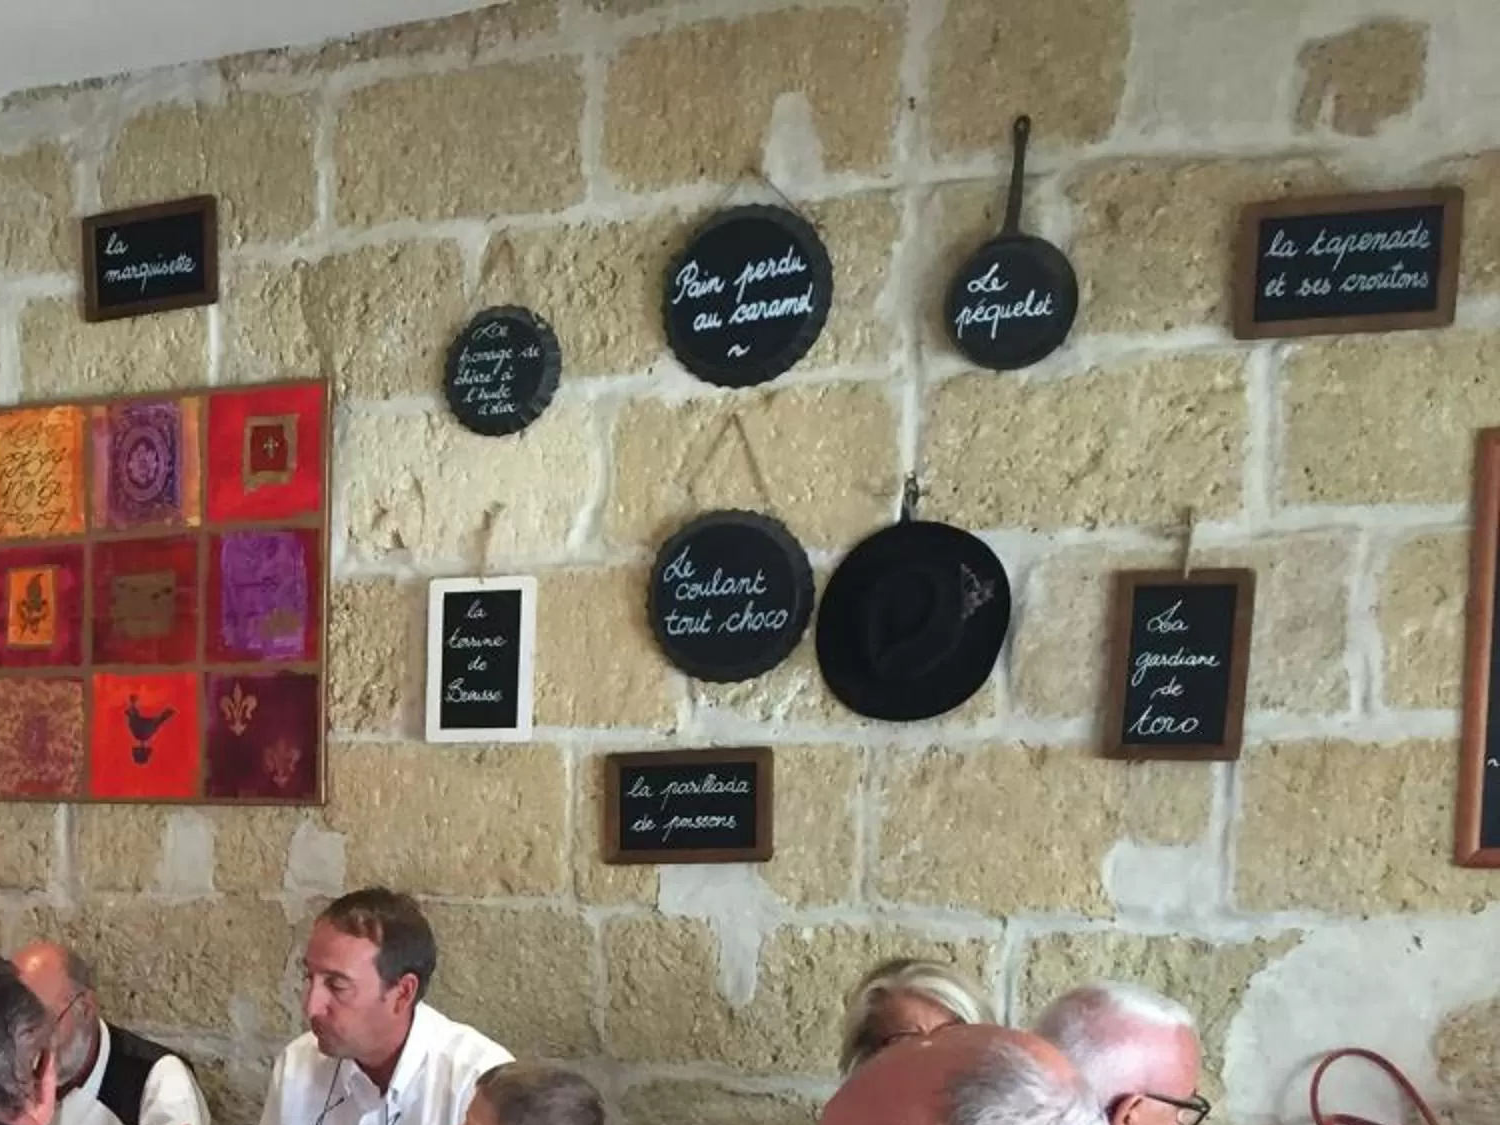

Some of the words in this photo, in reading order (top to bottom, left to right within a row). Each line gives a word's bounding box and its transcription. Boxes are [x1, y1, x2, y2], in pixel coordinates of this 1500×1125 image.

[1304, 217, 1432, 273] tapenade
[672, 259, 726, 305] Pain
[733, 243, 808, 305] perdu
[966, 261, 1010, 293] Le
[1263, 271, 1288, 298] et
[1294, 273, 1332, 298] ses
[693, 311, 723, 332] au
[728, 281, 815, 325] caramel
[663, 543, 698, 583] Le
[675, 567, 768, 601] coulant
[663, 607, 713, 636] tout
[717, 599, 790, 634] choco
[1147, 599, 1190, 634] La
[1131, 646, 1222, 688] gardiane
[1150, 675, 1186, 701] de
[1128, 704, 1200, 736] toro
[629, 812, 658, 832] de
